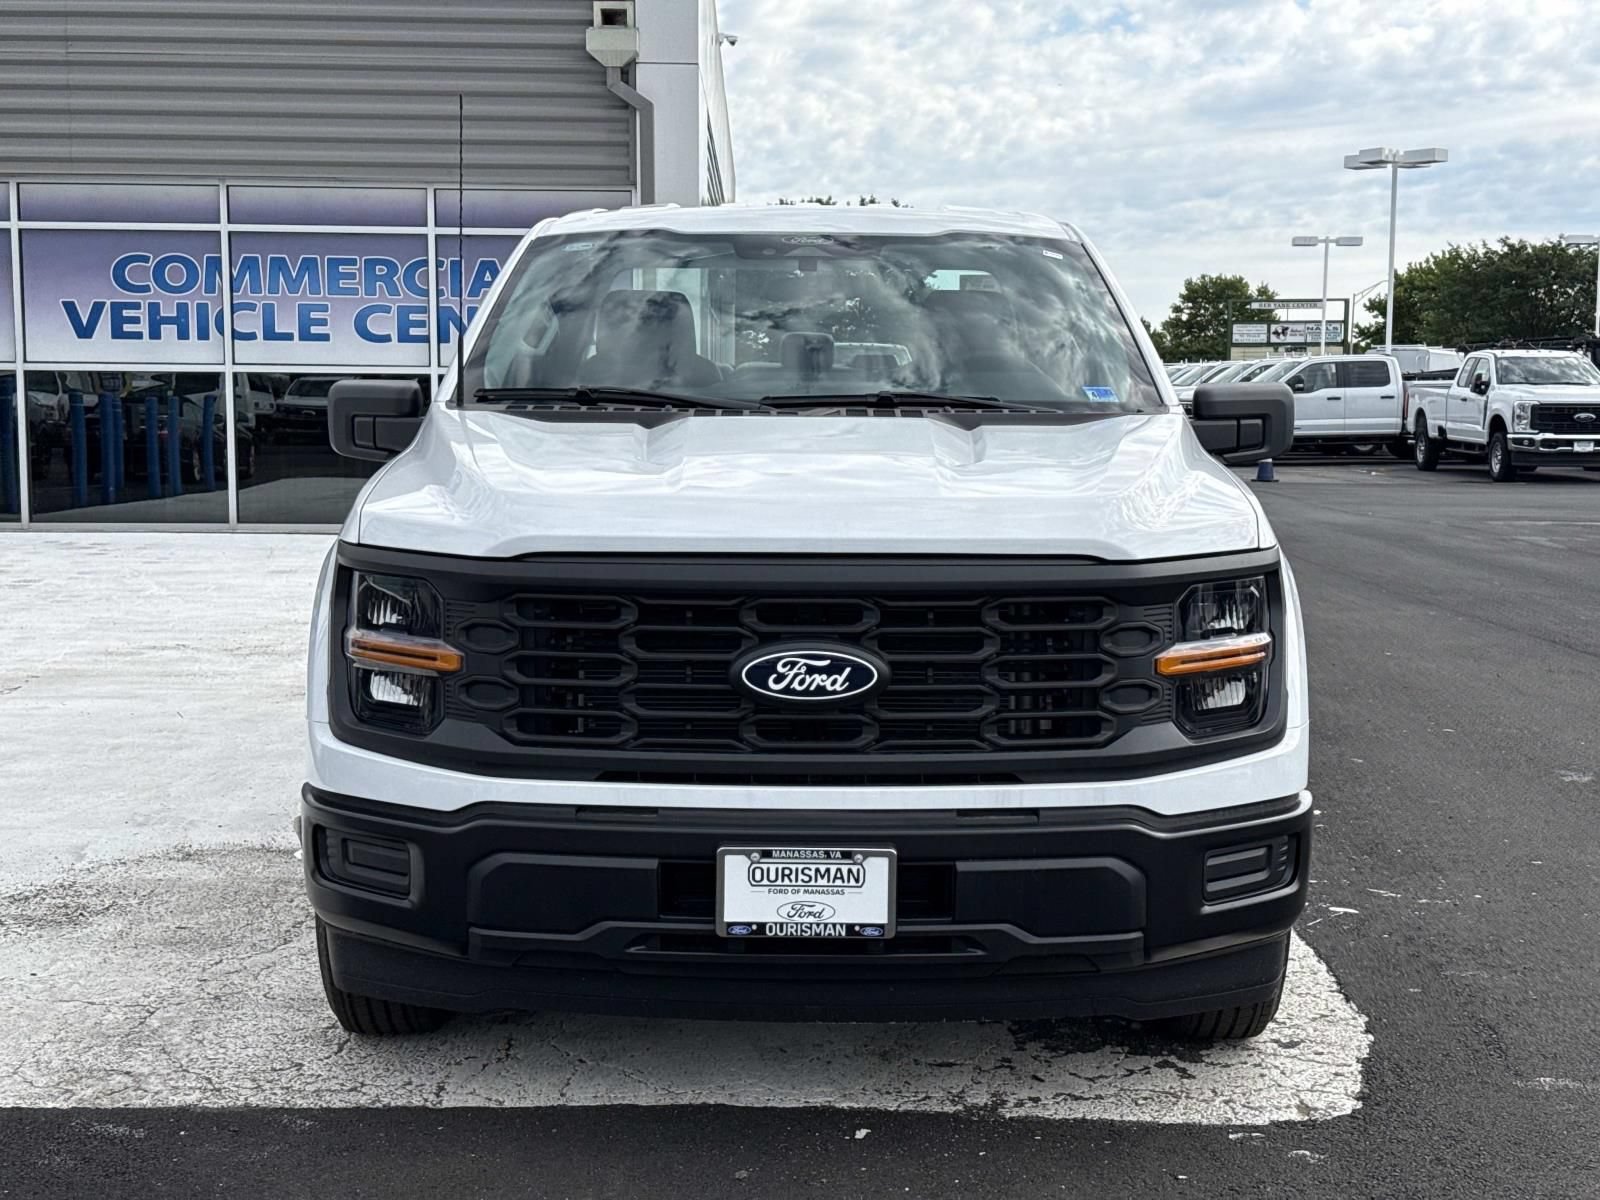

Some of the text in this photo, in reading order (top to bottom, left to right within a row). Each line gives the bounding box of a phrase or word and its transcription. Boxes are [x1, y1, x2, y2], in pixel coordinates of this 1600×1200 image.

[60, 300, 332, 343] VEHICLE
[768, 657, 852, 691] Ford
[830, 851, 842, 859] VA
[751, 866, 861, 884] OURISMAN
[803, 888, 846, 896] MANASSAS
[786, 903, 825, 919] Ford
[765, 922, 846, 937] OURISMAN
